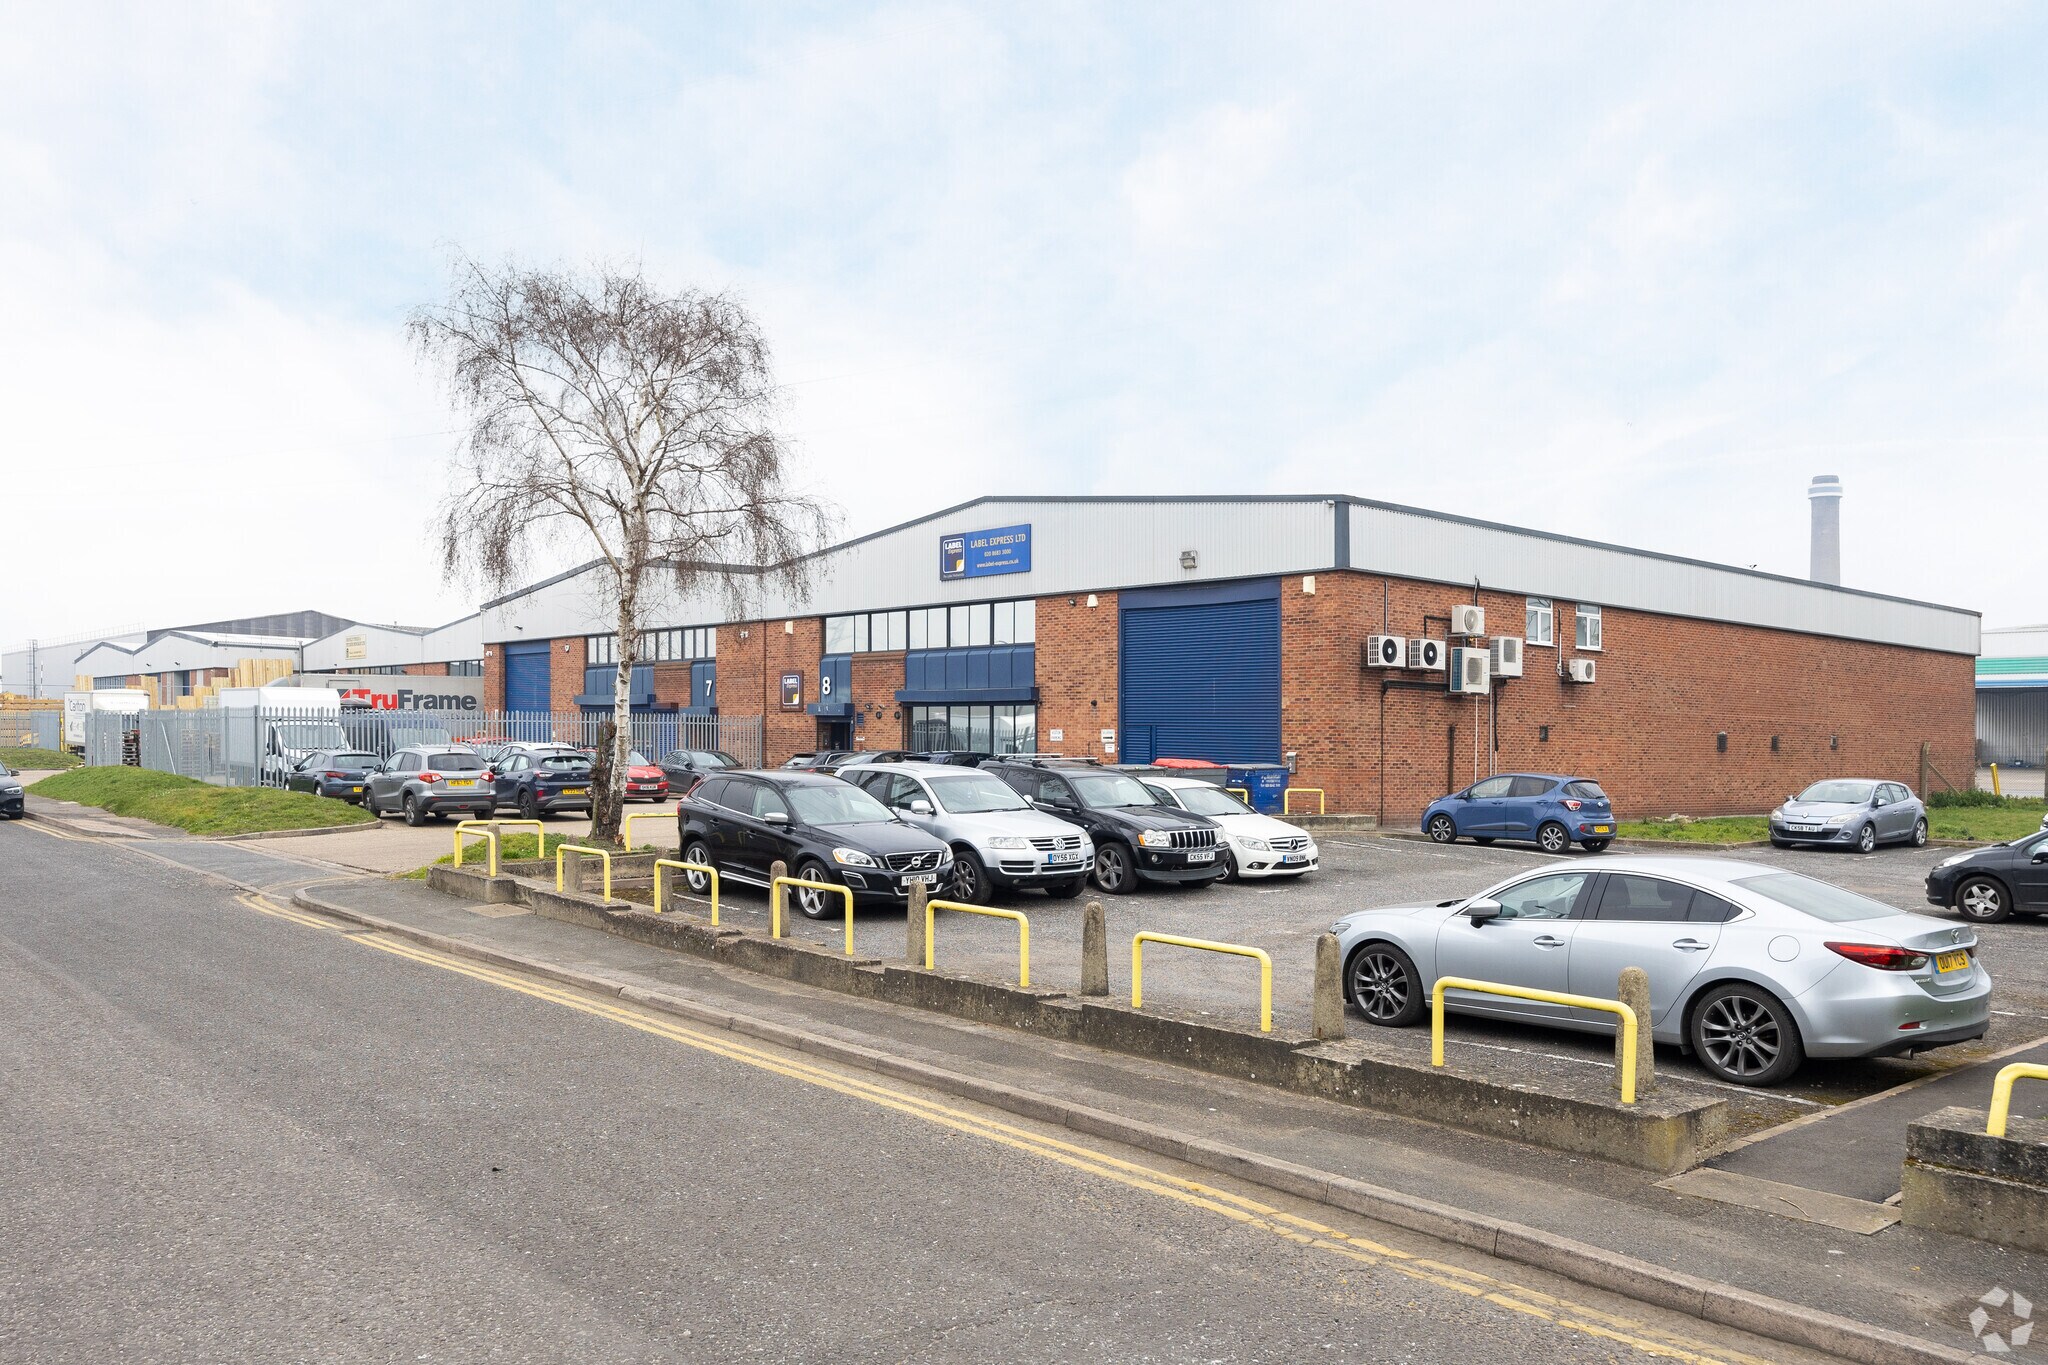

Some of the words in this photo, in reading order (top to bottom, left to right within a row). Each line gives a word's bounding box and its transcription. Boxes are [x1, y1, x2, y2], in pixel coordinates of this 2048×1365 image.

[944, 541, 963, 550] LABEL
[971, 539, 988, 549] LABEL
[990, 535, 1014, 546] EXPRESS
[1015, 533, 1026, 543] LTD
[705, 680, 712, 697] 7
[822, 676, 831, 695] 8
[352, 688, 477, 710] TruFrame
[1190, 853, 1203, 861] CK55
[1204, 852, 1214, 860] VFJ
[921, 874, 934, 883] VHJ
